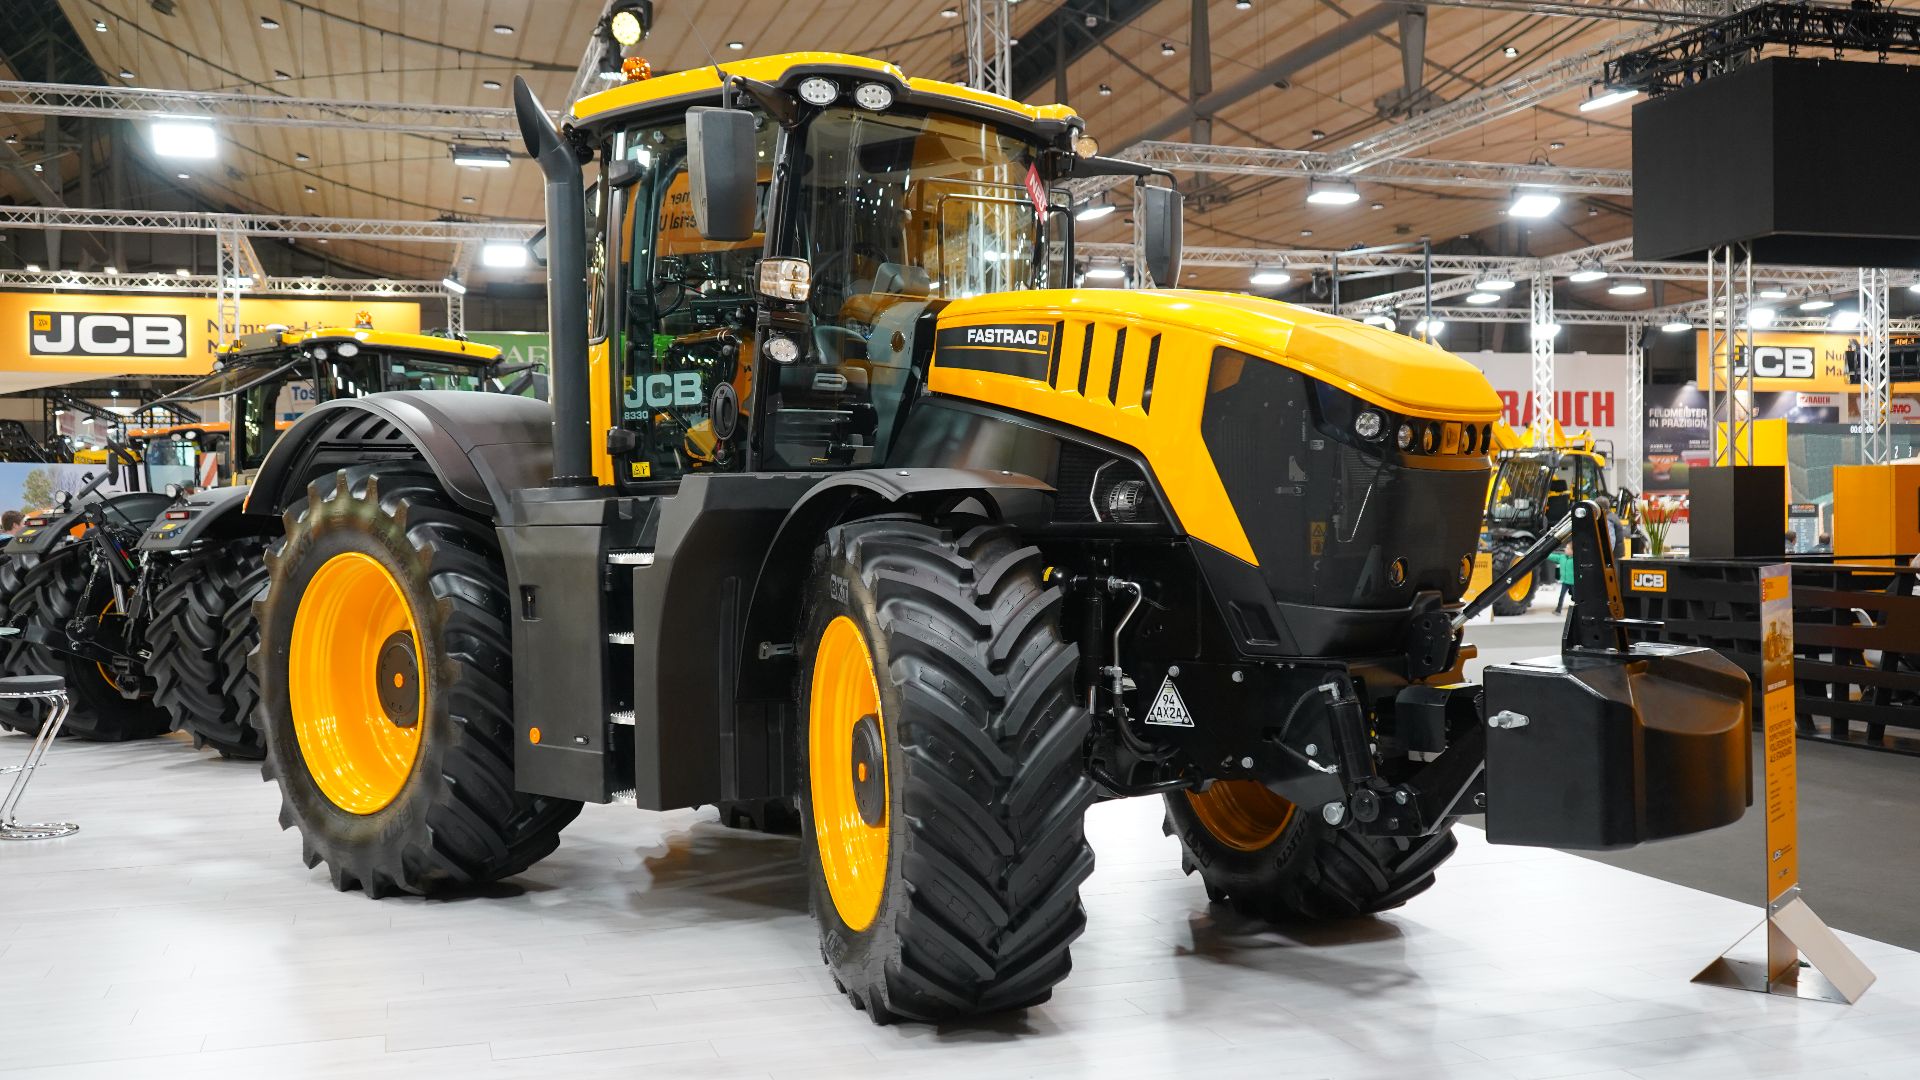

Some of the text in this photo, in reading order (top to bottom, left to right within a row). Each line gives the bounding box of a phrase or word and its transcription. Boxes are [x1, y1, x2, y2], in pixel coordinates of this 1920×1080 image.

[1030, 174, 1046, 211] NEU
[33, 314, 184, 354] JCB
[967, 328, 1038, 345] FASTRAC
[624, 372, 703, 409] JCB
[624, 410, 649, 420] 8330
[1648, 419, 1659, 428] IN
[1634, 573, 1664, 588] JCB
[1162, 694, 1175, 705] 94
[1156, 706, 1183, 720] AX2A
